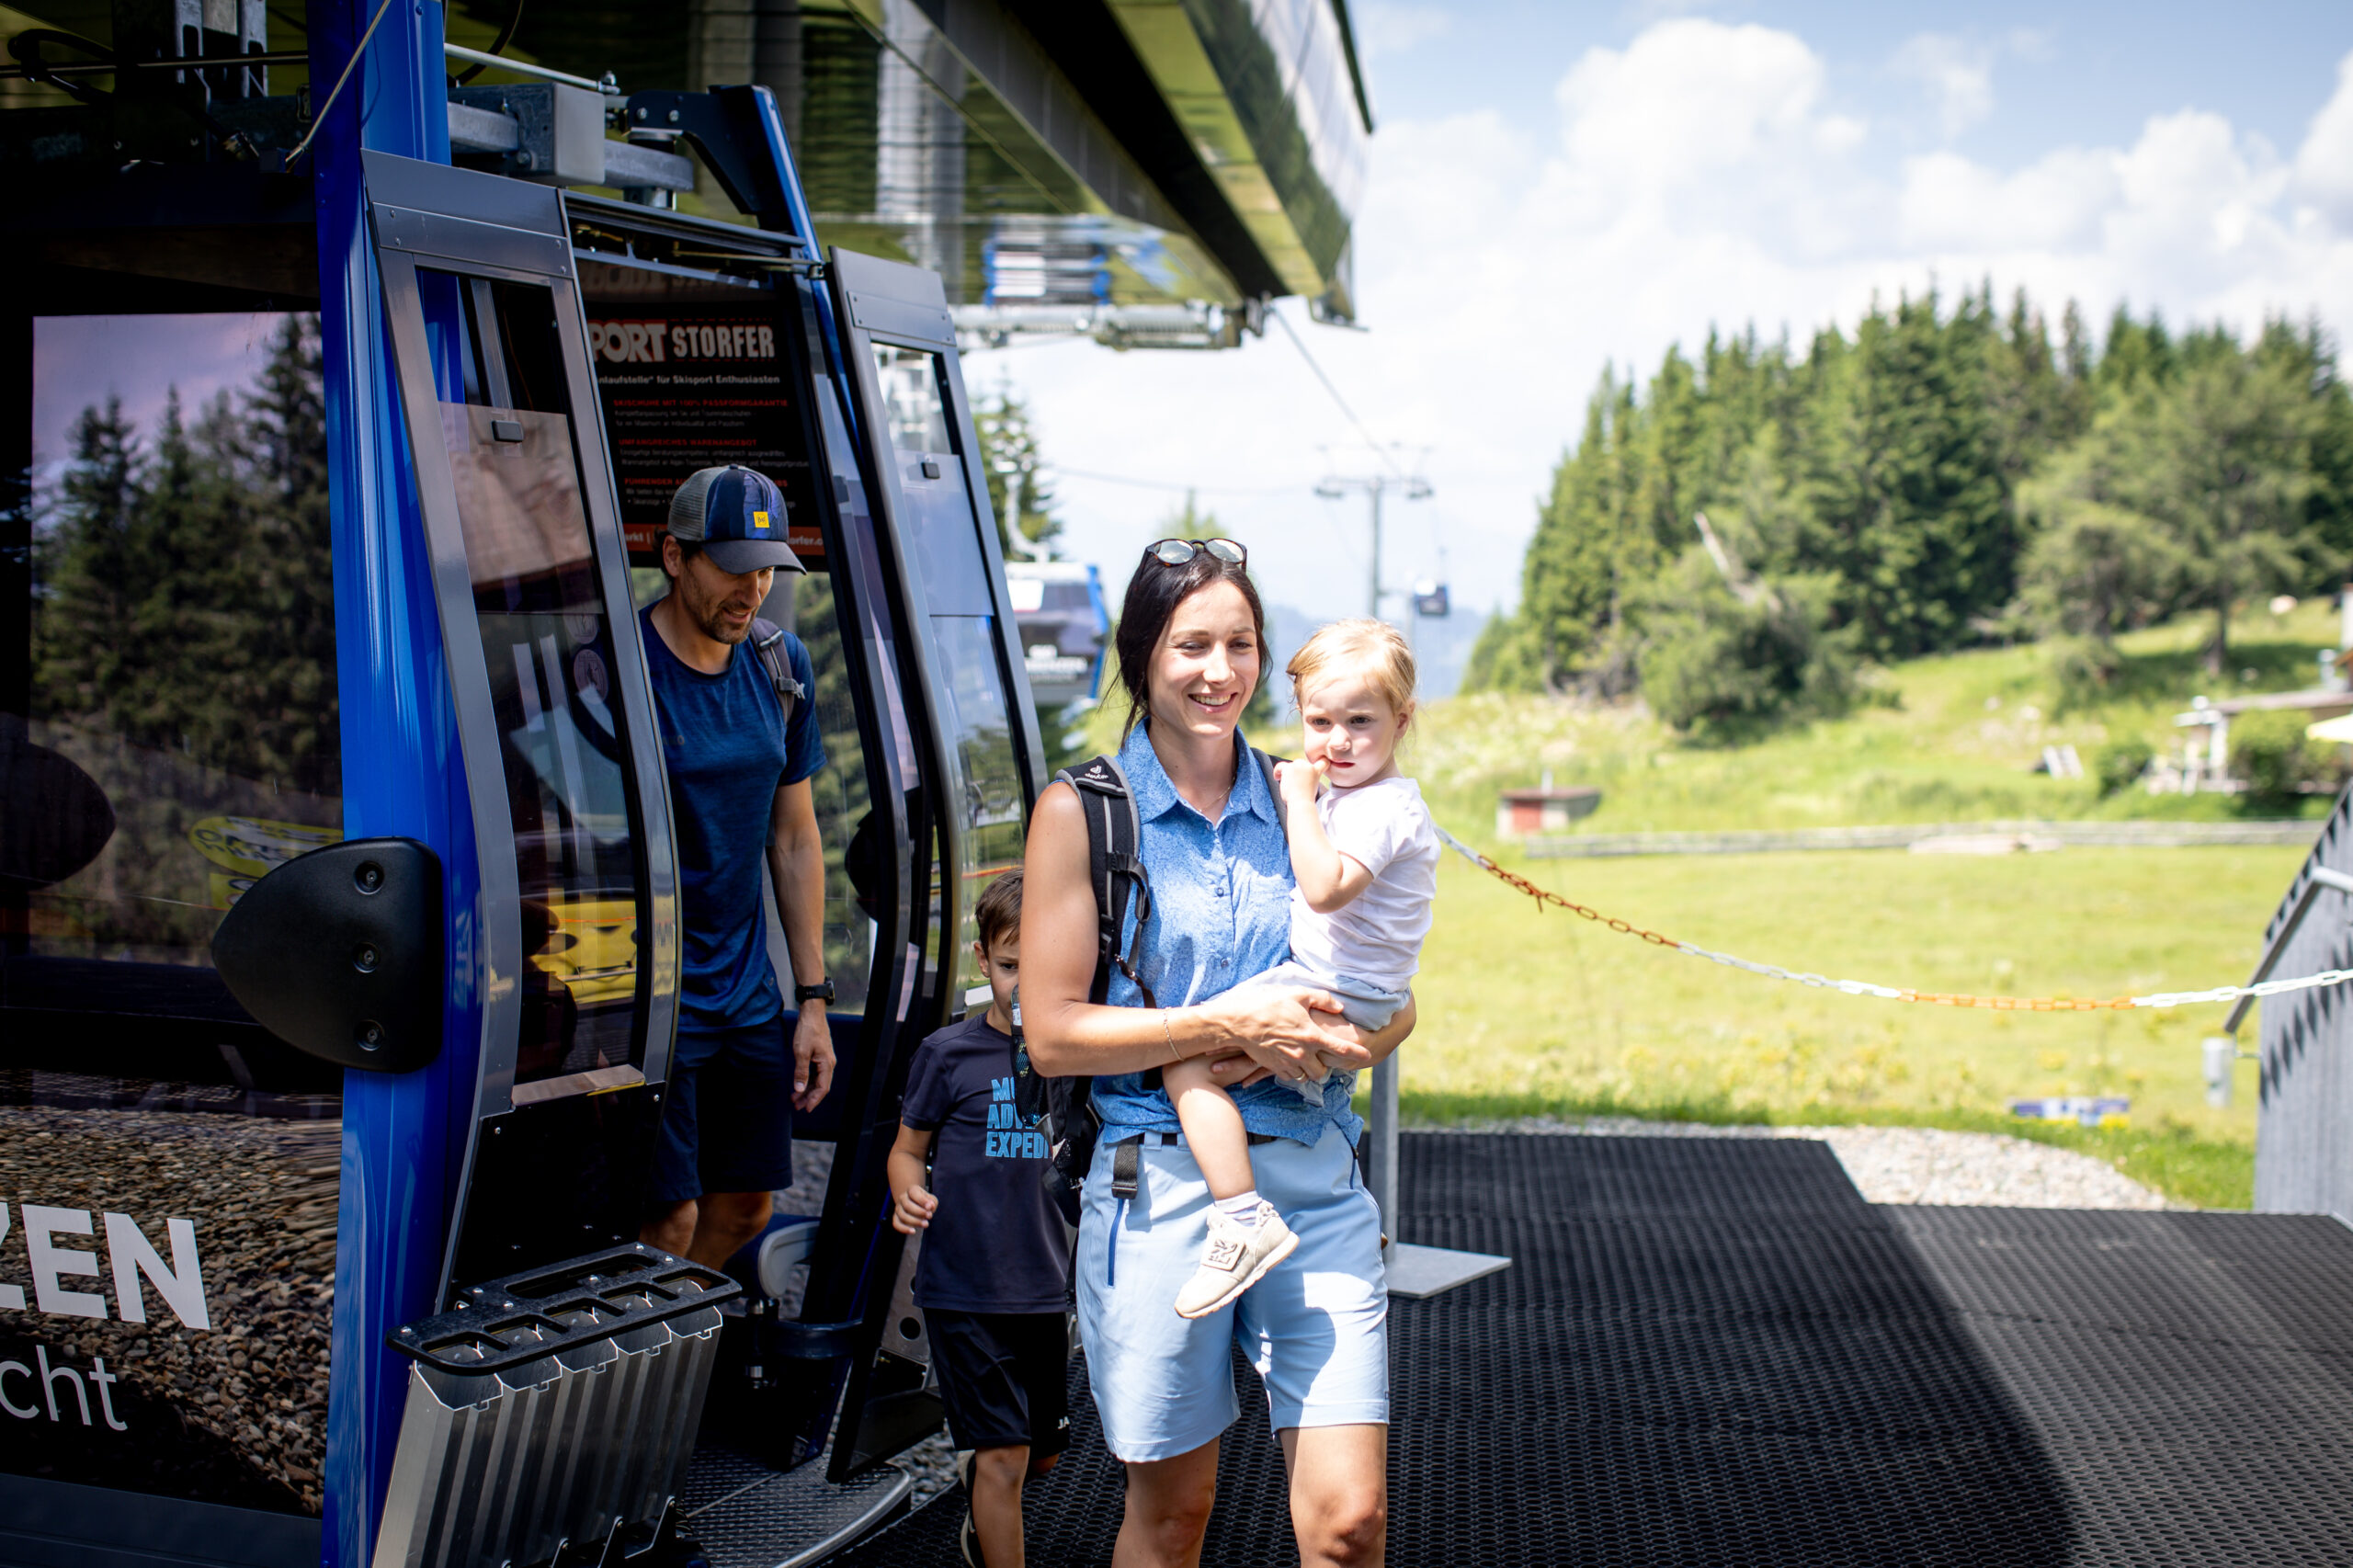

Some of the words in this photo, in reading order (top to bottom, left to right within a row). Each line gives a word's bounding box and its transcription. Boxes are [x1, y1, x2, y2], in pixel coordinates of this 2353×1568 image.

[672, 325, 775, 358] STORFER
[656, 375, 670, 384] für
[673, 375, 713, 385] Skisport
[716, 375, 780, 384] Enthusiasten
